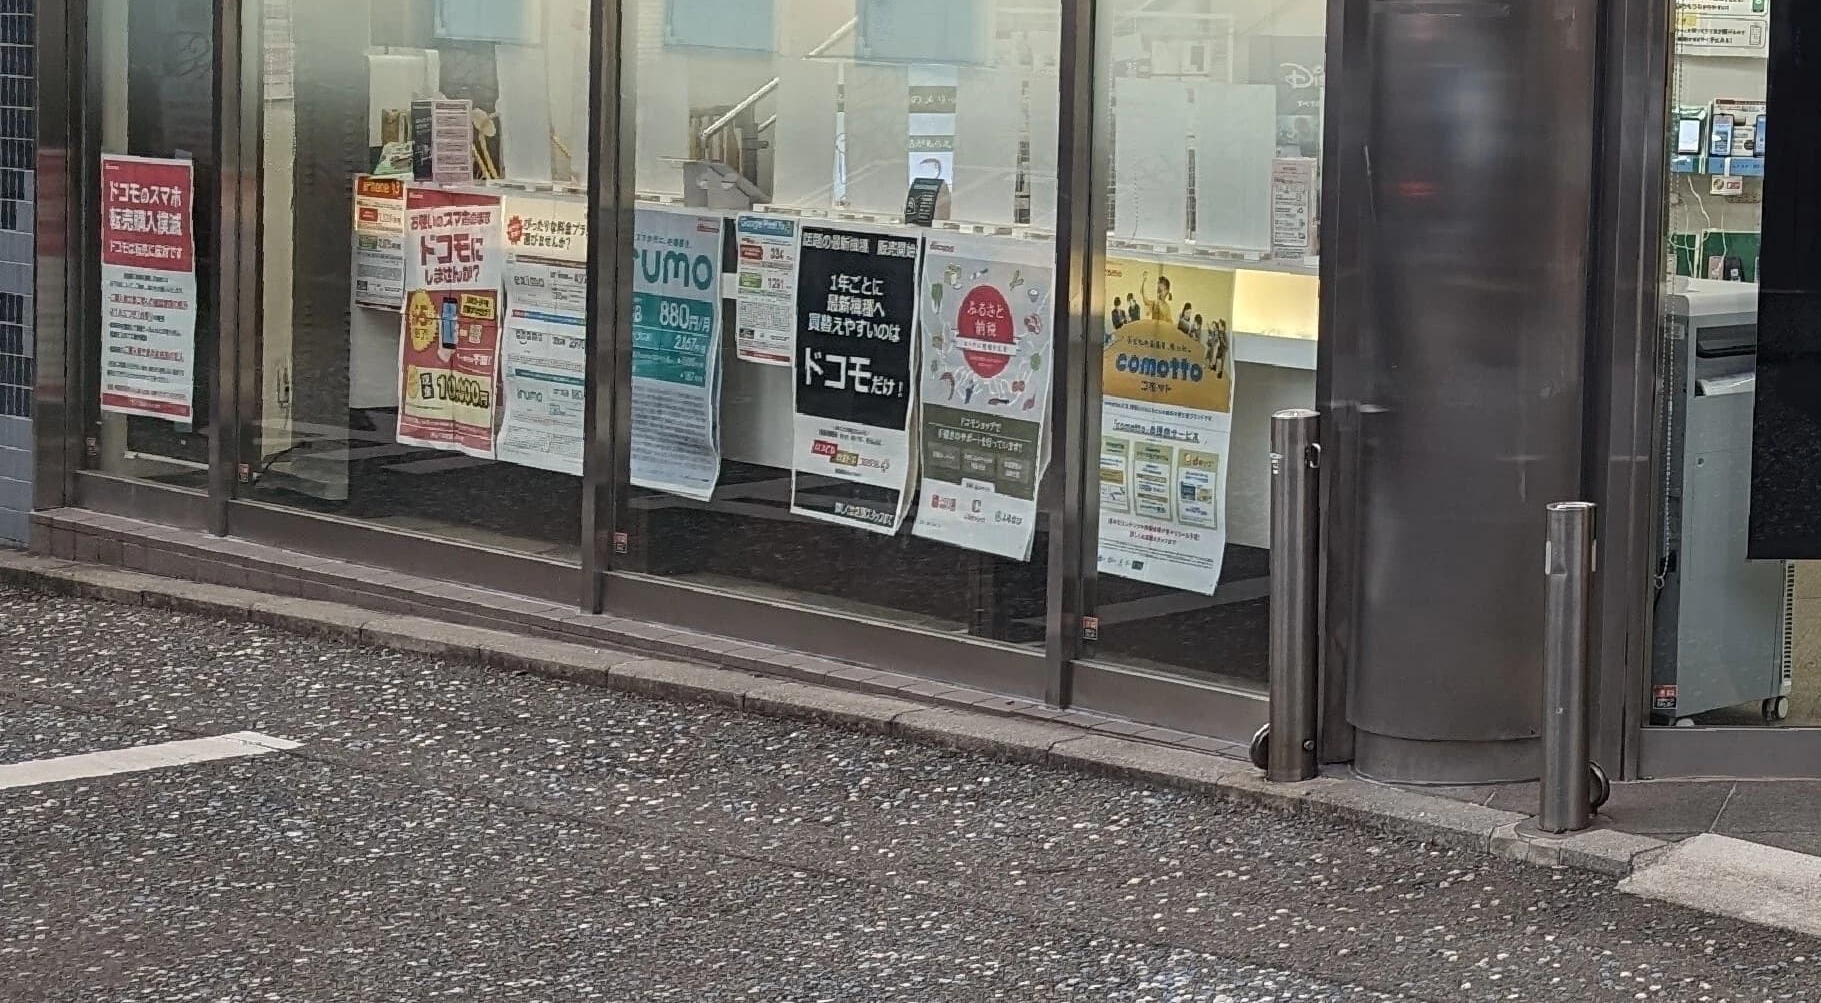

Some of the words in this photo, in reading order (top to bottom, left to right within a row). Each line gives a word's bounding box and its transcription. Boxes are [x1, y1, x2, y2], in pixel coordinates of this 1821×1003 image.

[109, 180, 182, 207] ドコモのスマホ
[420, 233, 483, 266] ドコモに
[634, 248, 713, 290] umo
[830, 273, 884, 295] 1年ごとに
[827, 293, 885, 317] 最新機種へ
[967, 301, 1004, 318] ふるさと
[808, 313, 900, 342] 買替えやすいのは
[1115, 353, 1203, 382] comotto
